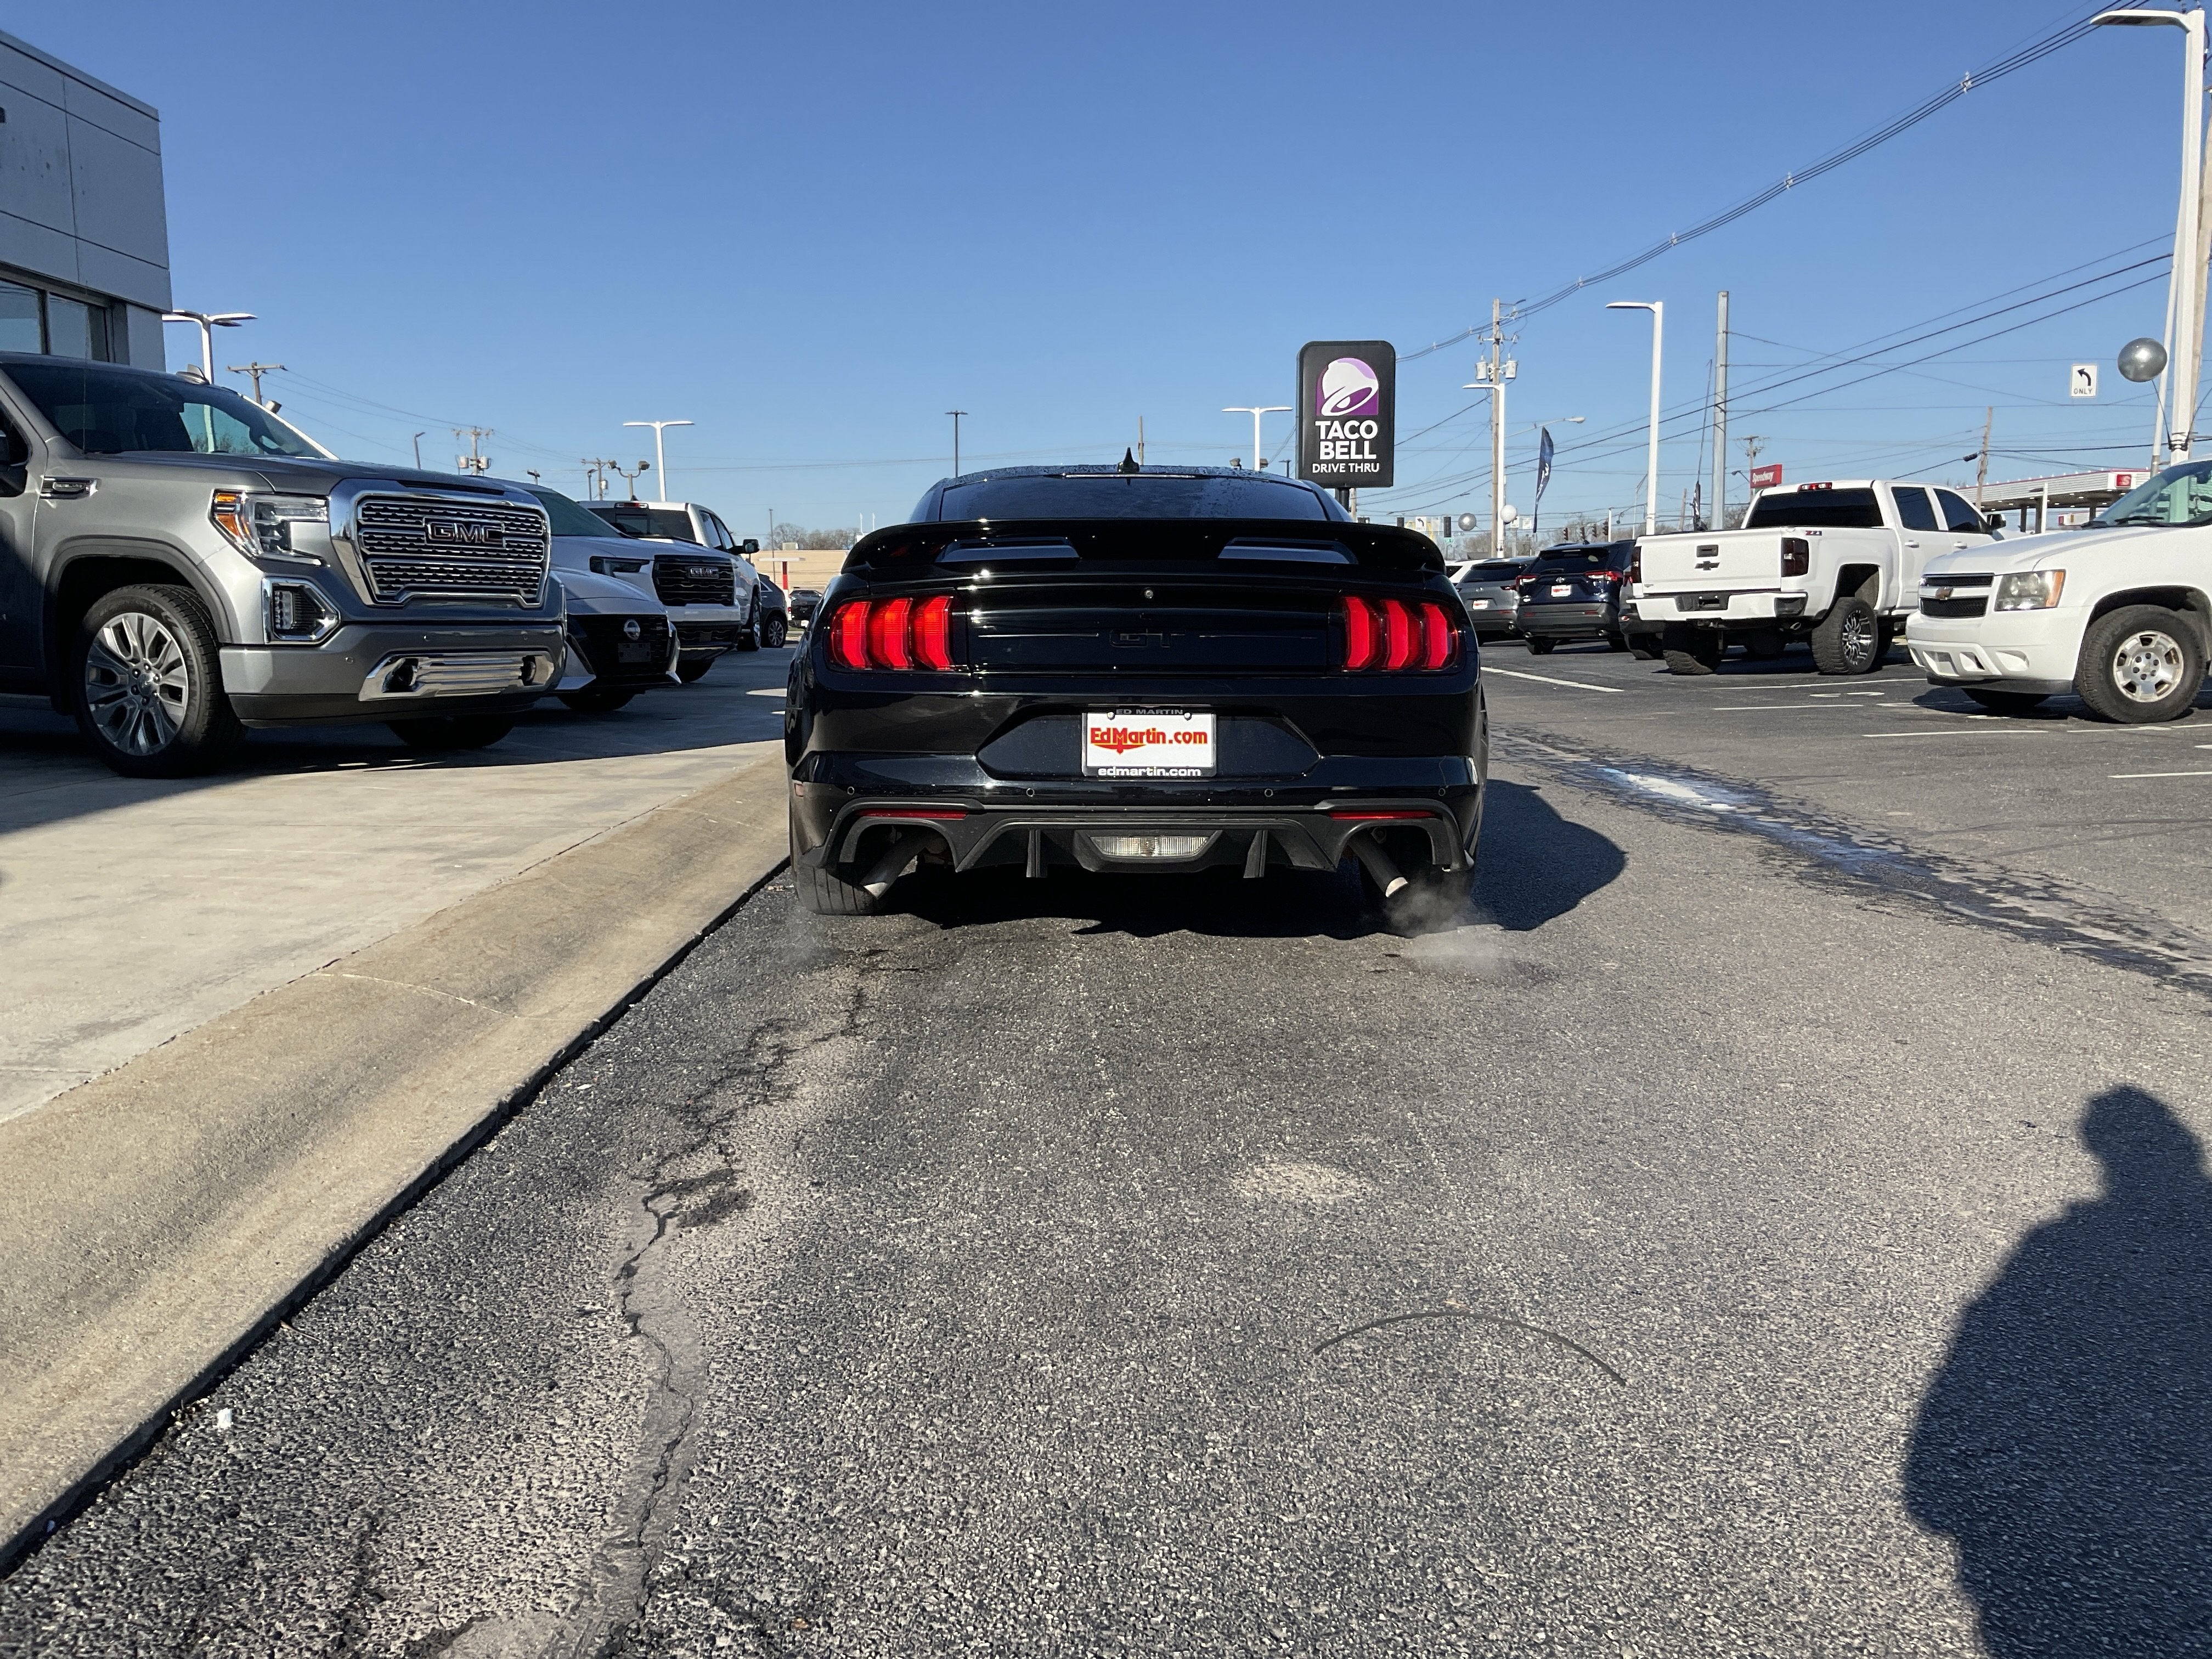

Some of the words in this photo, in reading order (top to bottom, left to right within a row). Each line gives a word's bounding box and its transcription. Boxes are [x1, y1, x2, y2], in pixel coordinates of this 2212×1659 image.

[1315, 420, 1378, 439] TACO
[1319, 441, 1376, 460] BELL
[1312, 463, 1346, 473] DRIVE
[1348, 462, 1380, 472] THRU
[427, 522, 503, 544] GMC
[690, 567, 719, 577] GMC
[1098, 767, 1201, 777] edmartin.com
